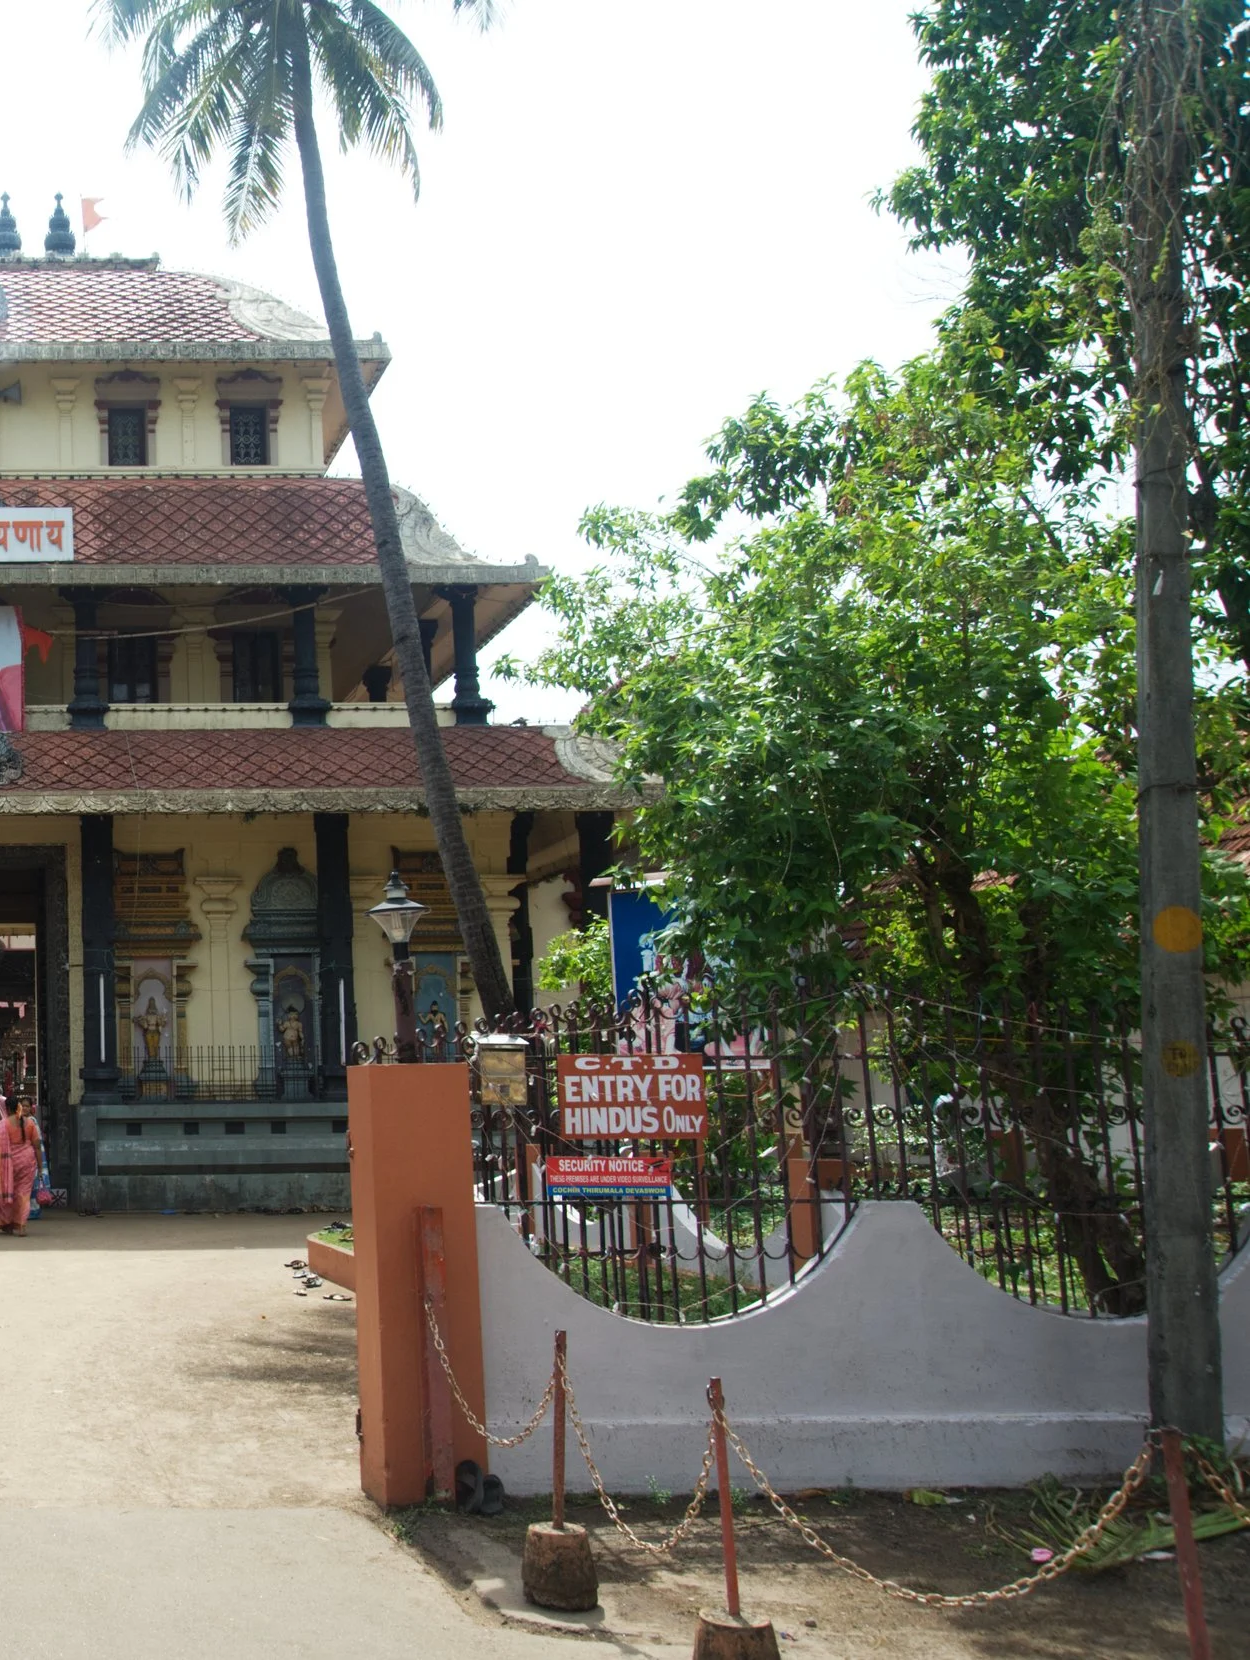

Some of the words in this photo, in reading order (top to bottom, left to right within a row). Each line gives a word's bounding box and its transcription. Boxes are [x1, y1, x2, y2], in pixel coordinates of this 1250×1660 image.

[575, 1056, 686, 1070] C.T.D.
[564, 1075, 652, 1102] ENTRY
[658, 1074, 701, 1102] FOR
[564, 1106, 659, 1134] HINDUS
[663, 1106, 703, 1133] ONLY
[558, 1159, 606, 1172] SECURITY
[608, 1159, 644, 1172] NOTICE
[550, 1175, 565, 1183] THESE
[565, 1175, 589, 1183] PREMISES
[589, 1175, 600, 1183] ARE
[600, 1175, 616, 1183] UNDER
[616, 1175, 632, 1183] VIDEO
[632, 1175, 668, 1184] SURVEILLANCE
